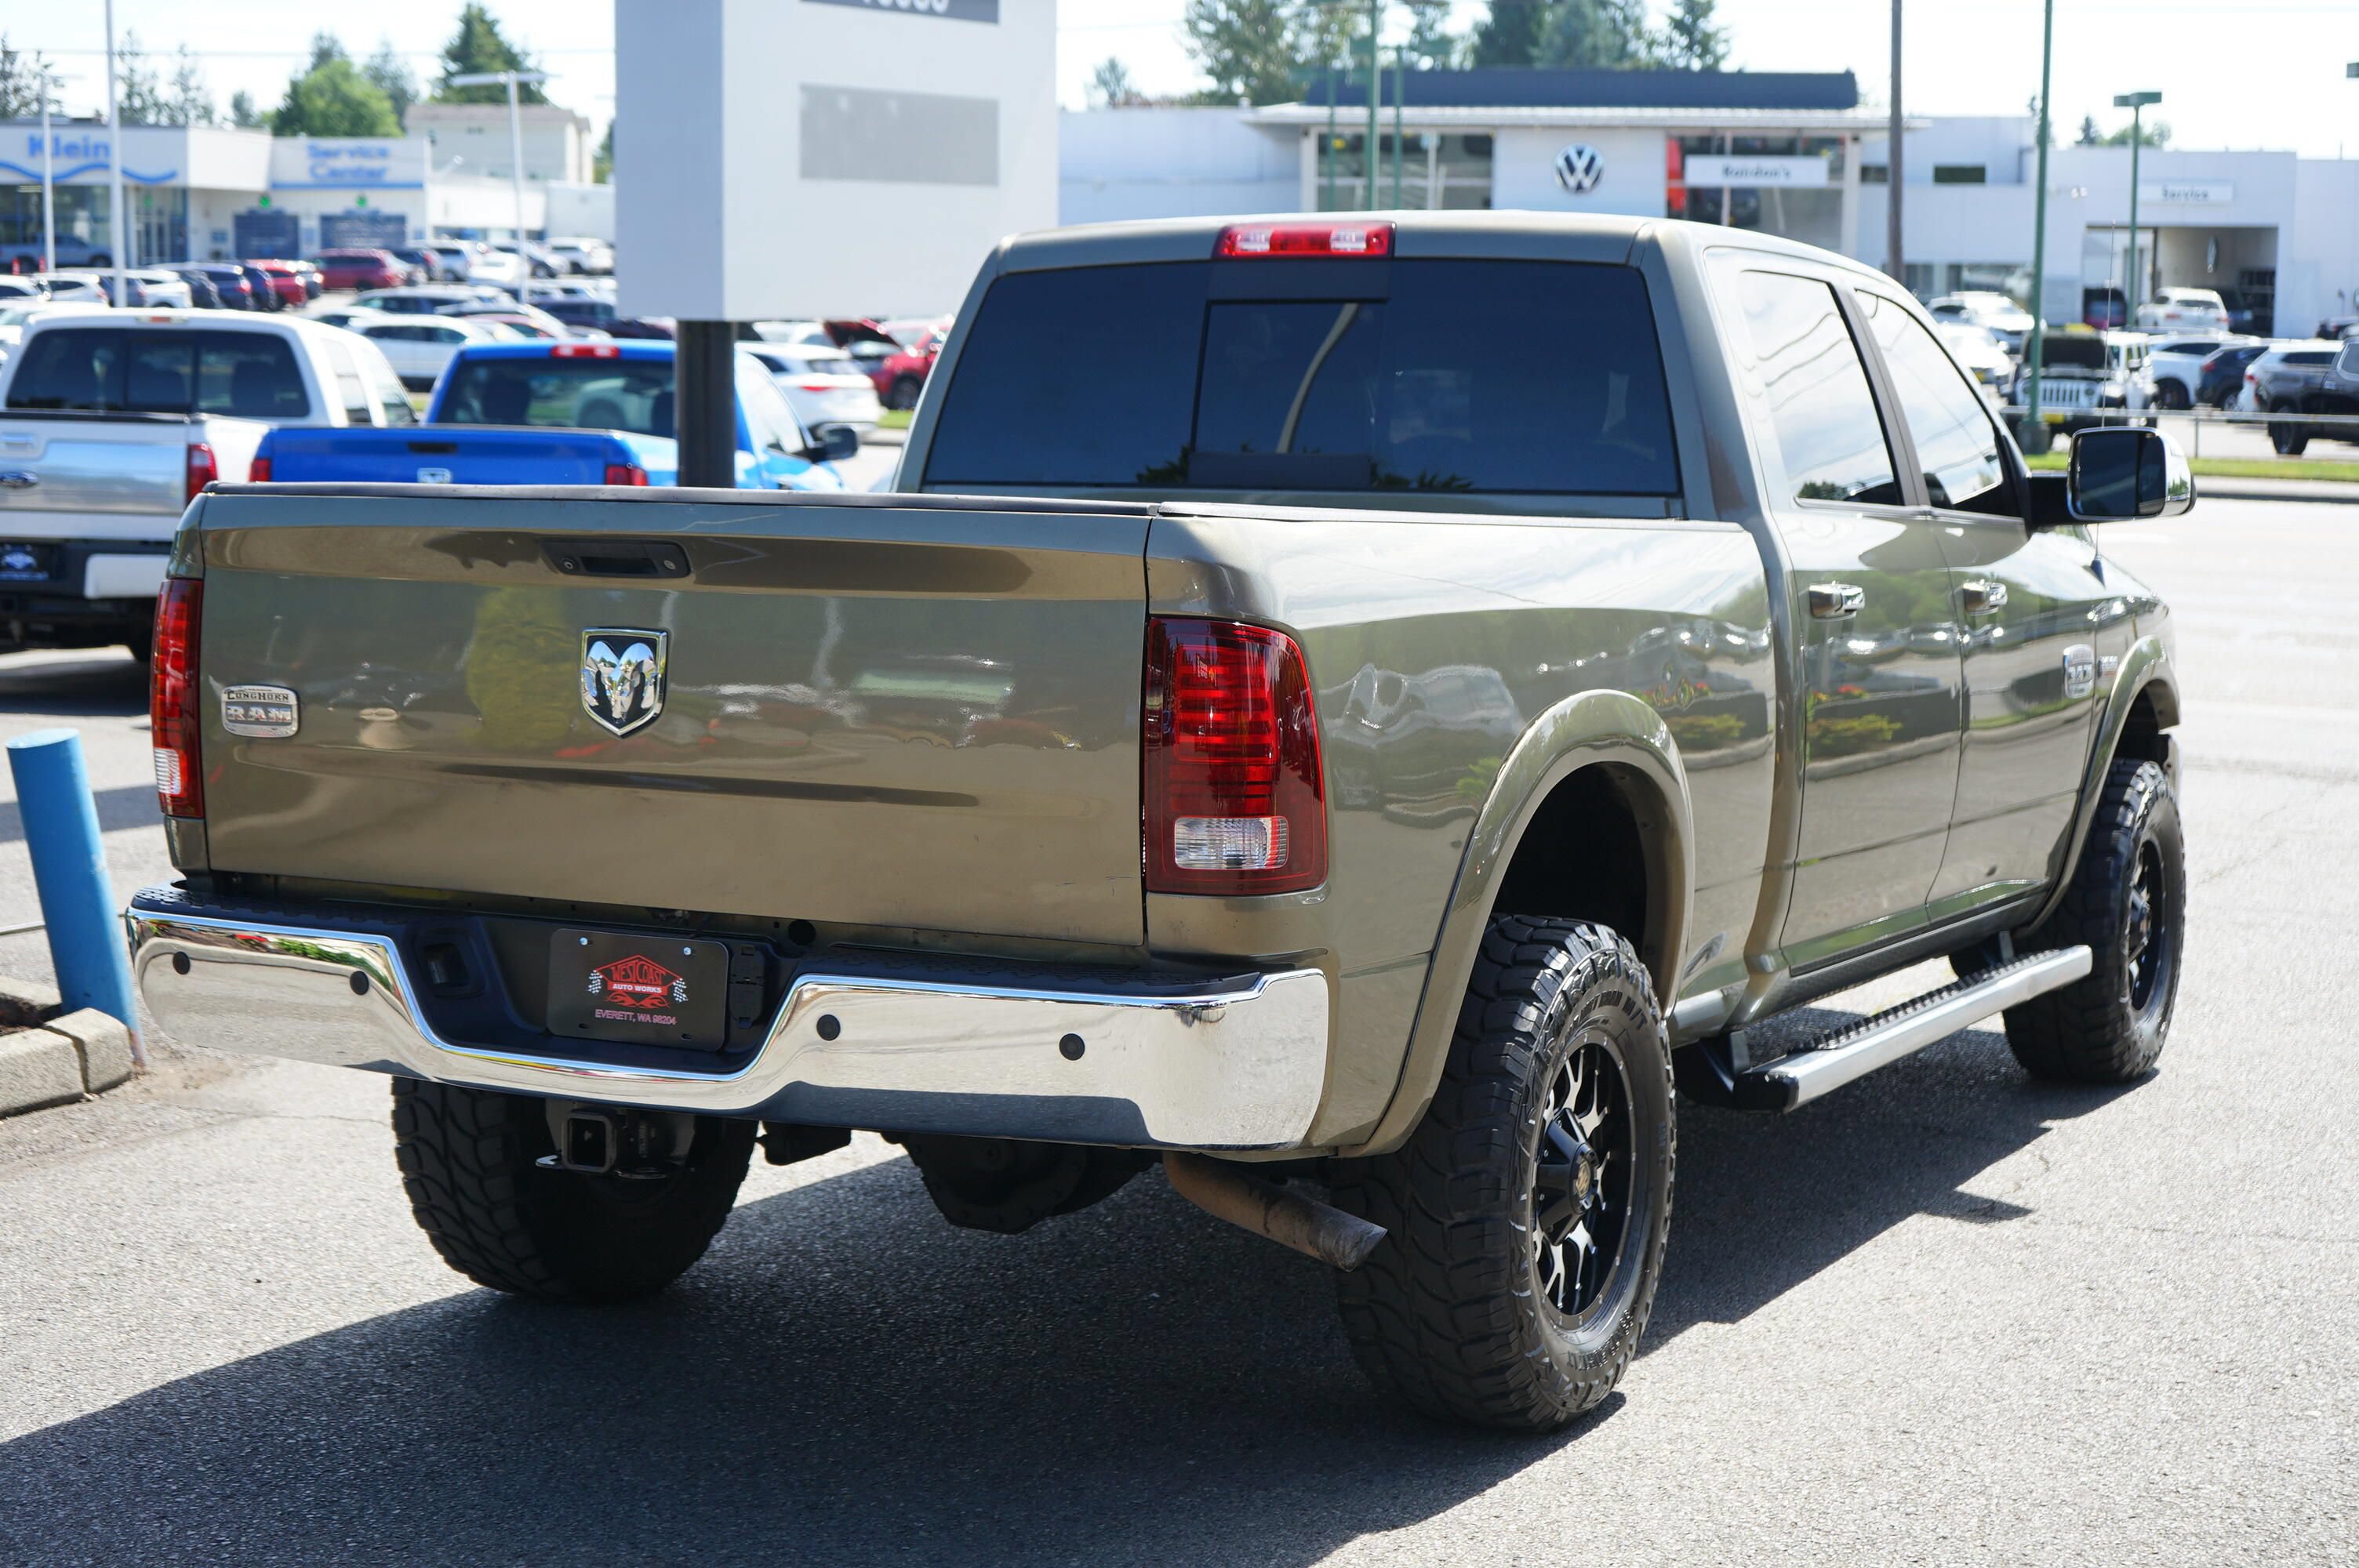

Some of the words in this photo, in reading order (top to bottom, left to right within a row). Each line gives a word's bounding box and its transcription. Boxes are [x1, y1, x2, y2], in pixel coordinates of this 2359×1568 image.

[226, 705, 292, 723] RAM
[634, 985, 663, 993] WORKS
[594, 1009, 635, 1022] EVERETT,
[637, 1012, 652, 1023] WA
